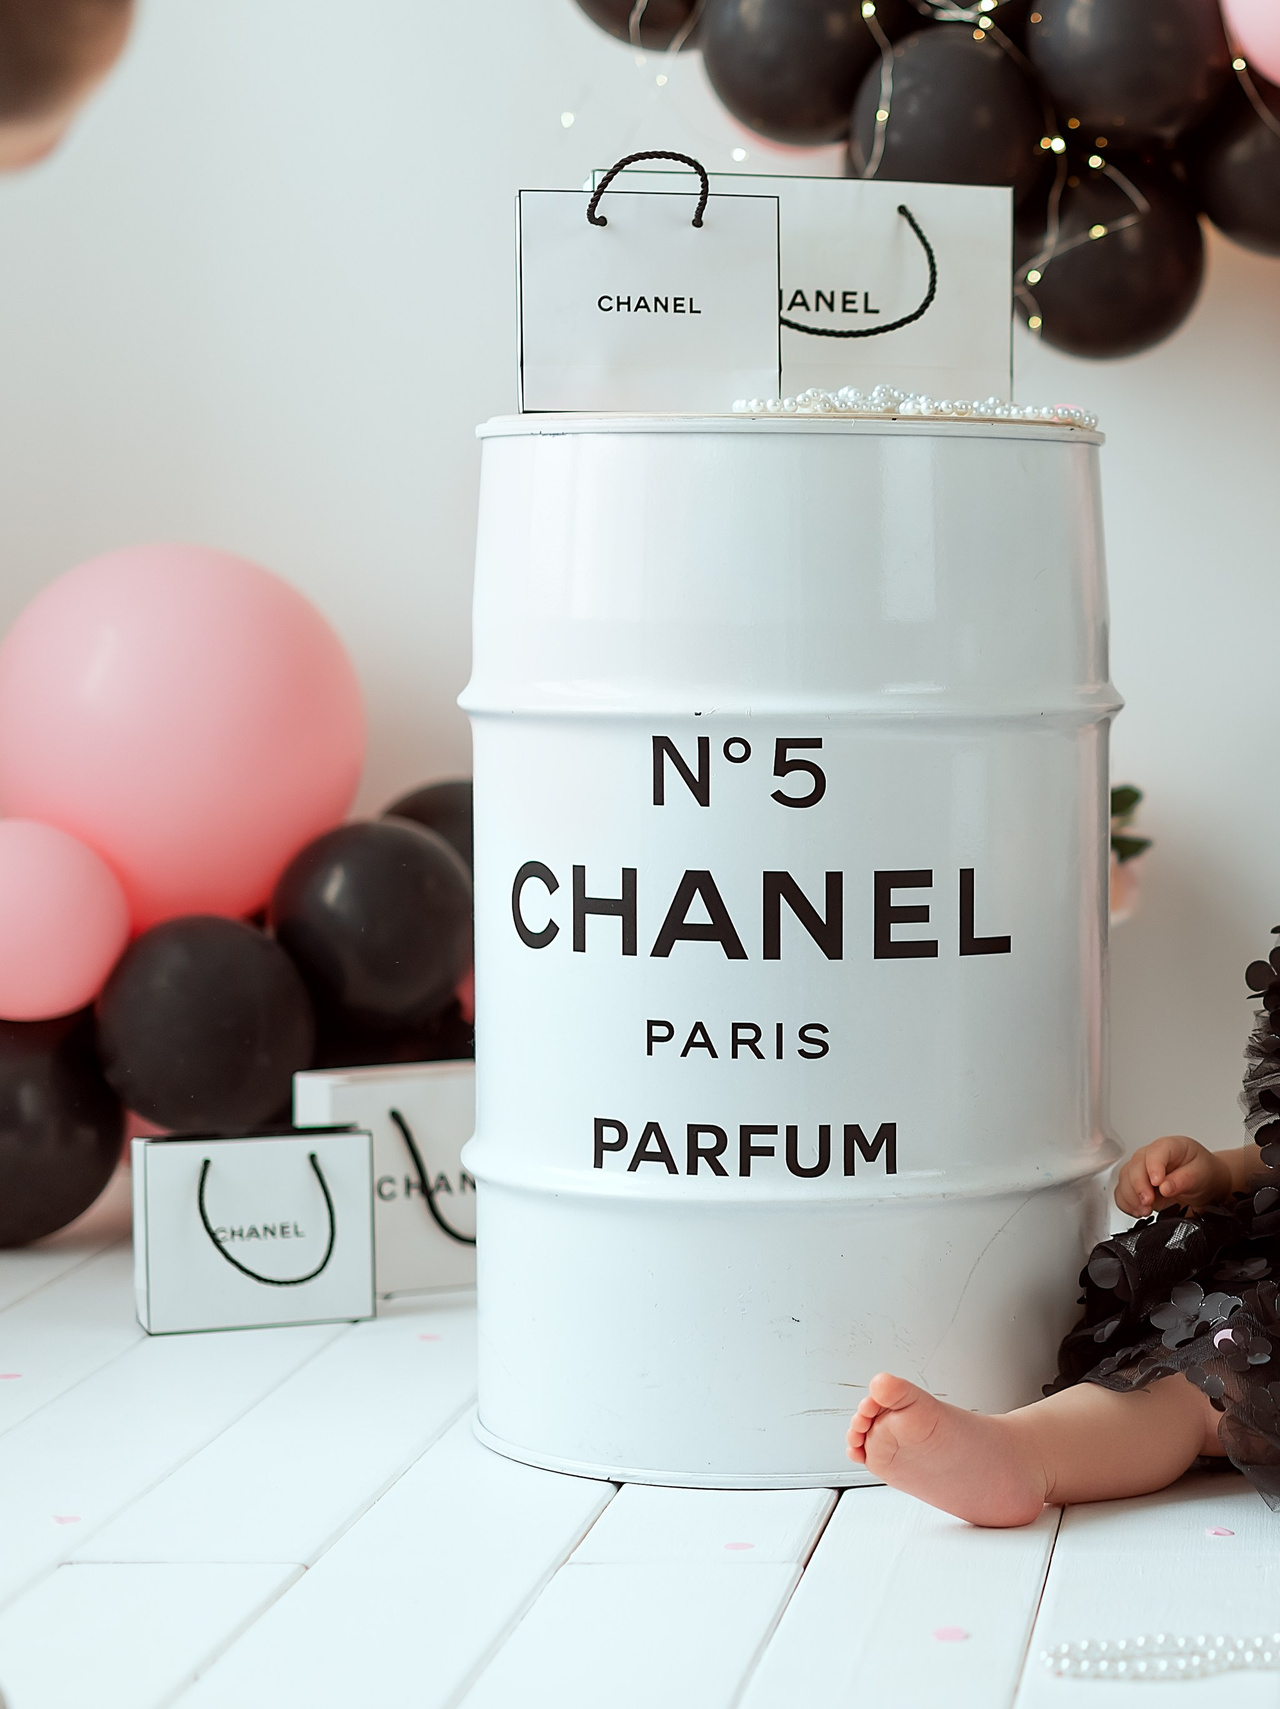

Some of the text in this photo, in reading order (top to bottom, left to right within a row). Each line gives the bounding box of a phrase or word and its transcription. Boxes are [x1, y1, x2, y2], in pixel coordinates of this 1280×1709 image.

[597, 294, 702, 315] CHANEL
[780, 288, 880, 314] ANEL
[511, 860, 1012, 961] CHANEL
[646, 1019, 831, 1060] PARIS
[593, 1117, 899, 1178] PARFUM
[212, 1221, 306, 1244] CHANEL
